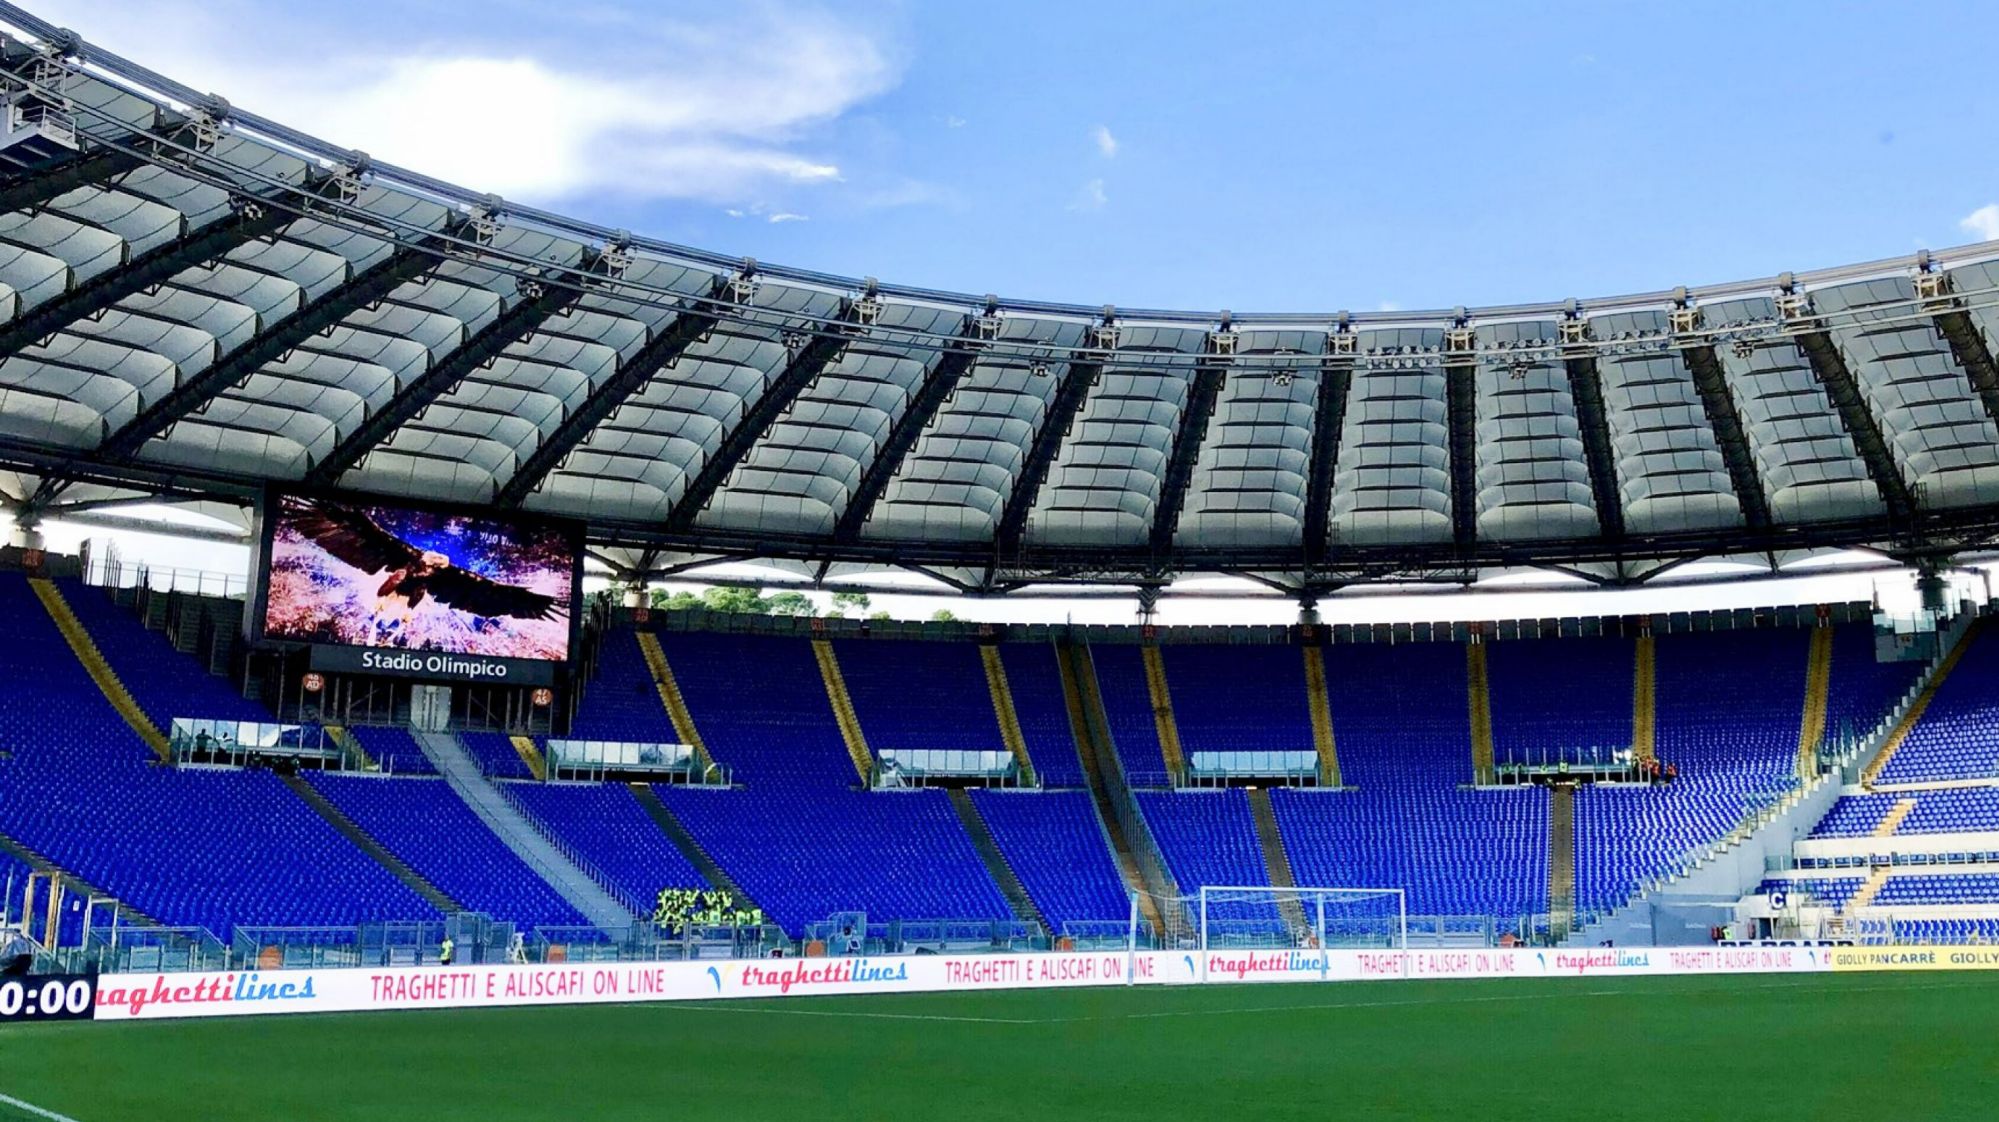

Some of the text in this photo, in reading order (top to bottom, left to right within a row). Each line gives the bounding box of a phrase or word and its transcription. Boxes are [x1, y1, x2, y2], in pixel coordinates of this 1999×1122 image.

[362, 652, 507, 678] Stadio Olimpico
[1771, 892, 1784, 909] C
[1418, 954, 1424, 973] E
[1429, 953, 1471, 973] ALISCAFI
[1475, 953, 1490, 972] ON
[1494, 953, 1515, 972] LINE
[1556, 950, 1650, 974] traghettilines
[1670, 951, 1792, 968] TRAGHETTI E ALISCAFI ON LINE
[1837, 953, 1867, 965] GIOLLY
[1870, 950, 1936, 965] PANCARRÈ
[1950, 953, 1999, 964] GIOLLY
[742, 959, 909, 993] traghettilines
[945, 957, 1154, 983] TRAGHETTI E ALISCAFI ON INE
[370, 969, 665, 1001] TRAGHETTI E ALISCAFI ON LINE
[0, 980, 91, 1015] 0:00
